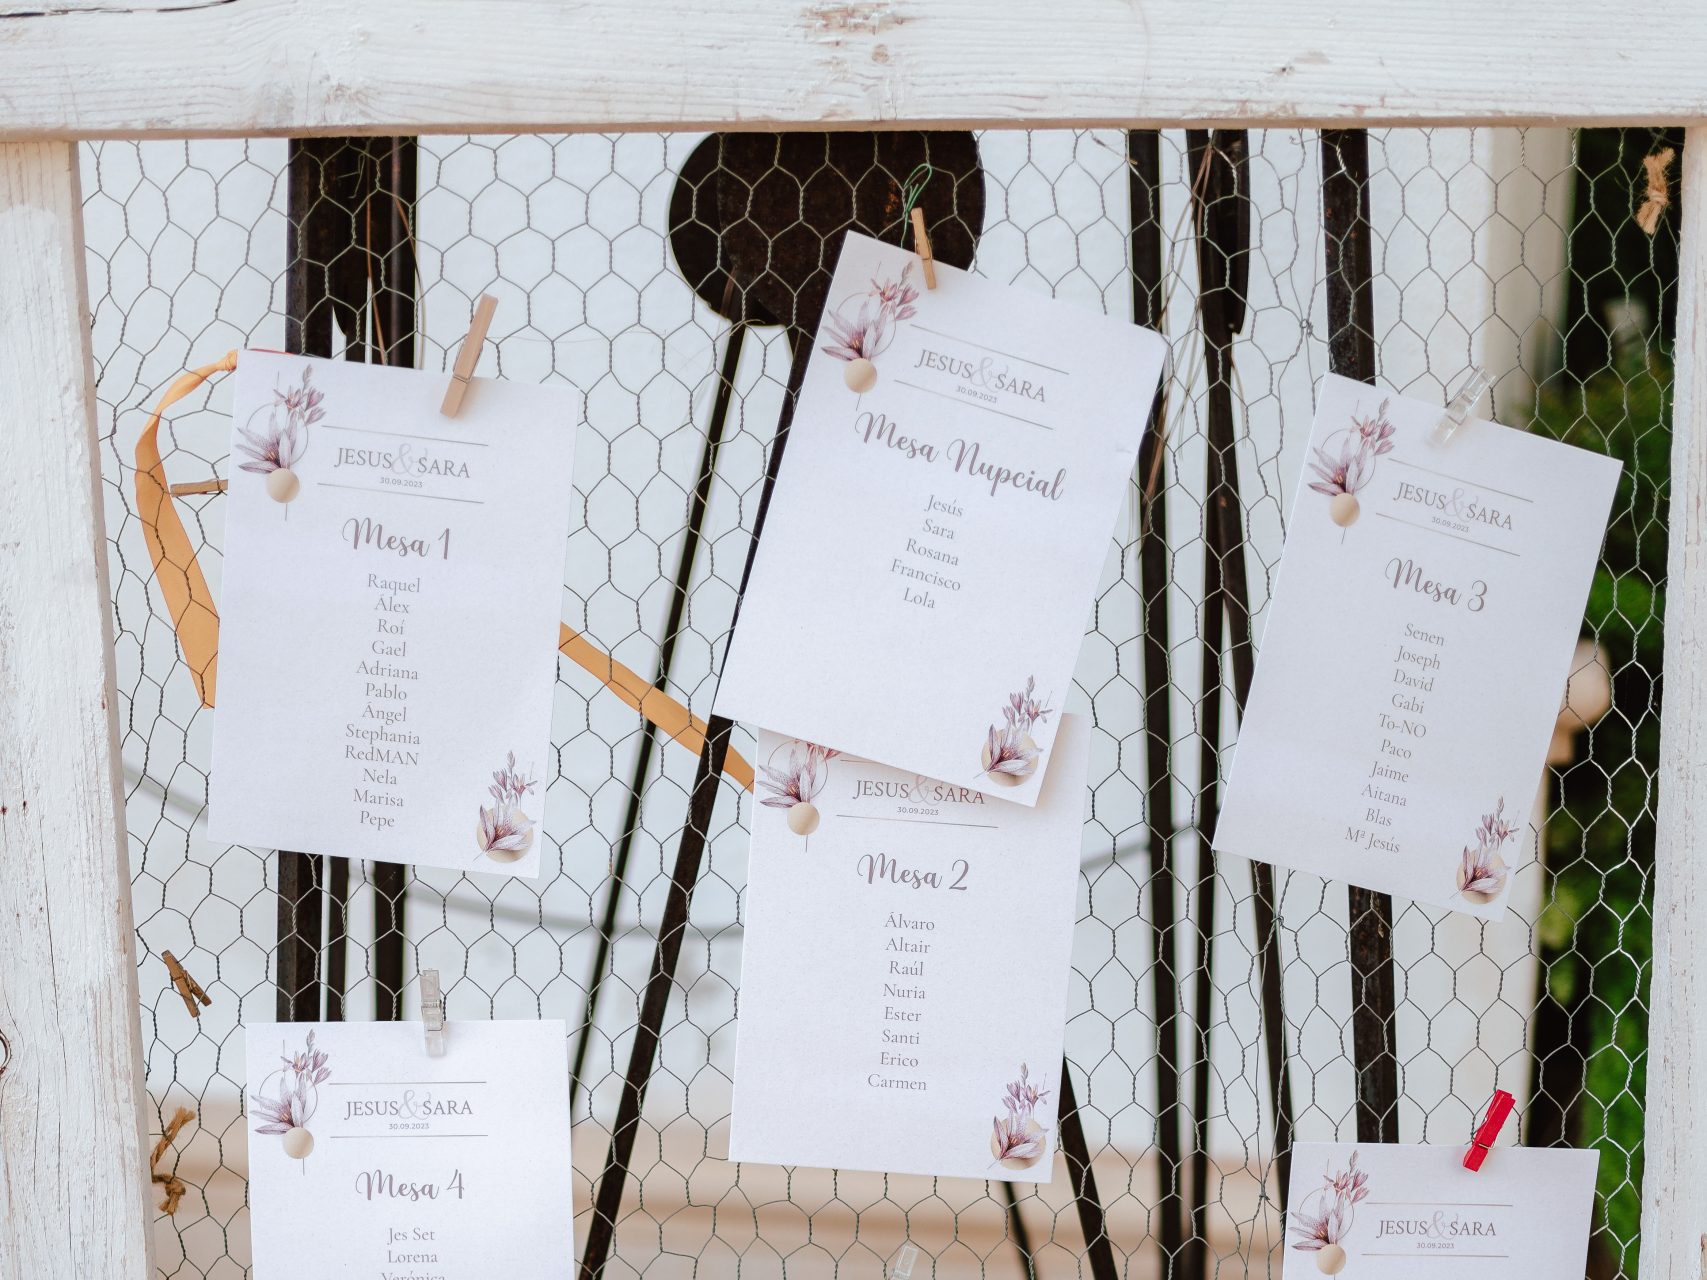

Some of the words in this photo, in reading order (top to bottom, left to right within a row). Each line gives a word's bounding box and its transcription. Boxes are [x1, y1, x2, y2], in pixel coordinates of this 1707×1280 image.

[956, 384, 999, 404] 30.09.2023
[854, 410, 940, 463] Mesa
[946, 437, 1068, 502] Nupcial
[379, 476, 424, 489] 30.09.2023
[924, 494, 963, 517] Jesús
[342, 516, 429, 559] Mesa
[436, 527, 451, 561] 1
[922, 518, 954, 540] Sara
[906, 538, 959, 566] Rosana
[368, 573, 420, 596] Raquel
[890, 558, 961, 591] Francisco
[1384, 556, 1463, 607] Mesa
[1466, 578, 1489, 614] 3
[903, 587, 935, 609] Lola
[1404, 623, 1444, 646] Senen
[371, 641, 406, 657] Gael
[1393, 645, 1440, 671] Joseph
[356, 660, 418, 680] Adriana
[1393, 669, 1434, 692] David
[365, 682, 407, 700] Pablo
[362, 701, 407, 726] Ángel
[1392, 694, 1425, 714] Gabi
[345, 724, 420, 745] Stephania
[345, 745, 419, 766] RedMAN
[1381, 739, 1412, 759] Paco
[363, 768, 397, 785] Nela
[1369, 761, 1409, 783] Jaime
[353, 788, 404, 807] Marisa
[1361, 783, 1406, 806] Aitana
[360, 810, 395, 831] Pepe
[897, 806, 939, 817] 30.09.2023
[1365, 808, 1392, 826] Blas
[1365, 833, 1400, 853] Jesús
[856, 851, 944, 891] Mesa
[948, 858, 970, 892] 2
[884, 911, 935, 931] Álvaro
[885, 937, 931, 953] Altair
[889, 960, 924, 976] Raúl
[883, 983, 925, 999] Nuria
[884, 1006, 922, 1022] Ester
[882, 1029, 920, 1045] Santi
[880, 1052, 919, 1068] Erico
[868, 1074, 927, 1091] Carmen
[388, 1122, 430, 1130] 30.09.2023
[354, 1167, 440, 1202] Mesa
[446, 1167, 465, 1200] 4
[387, 1227, 408, 1245] Jes
[413, 1227, 435, 1241] Set
[1416, 1242, 1455, 1250] 30.09.2023
[388, 1250, 438, 1263] Lorena
